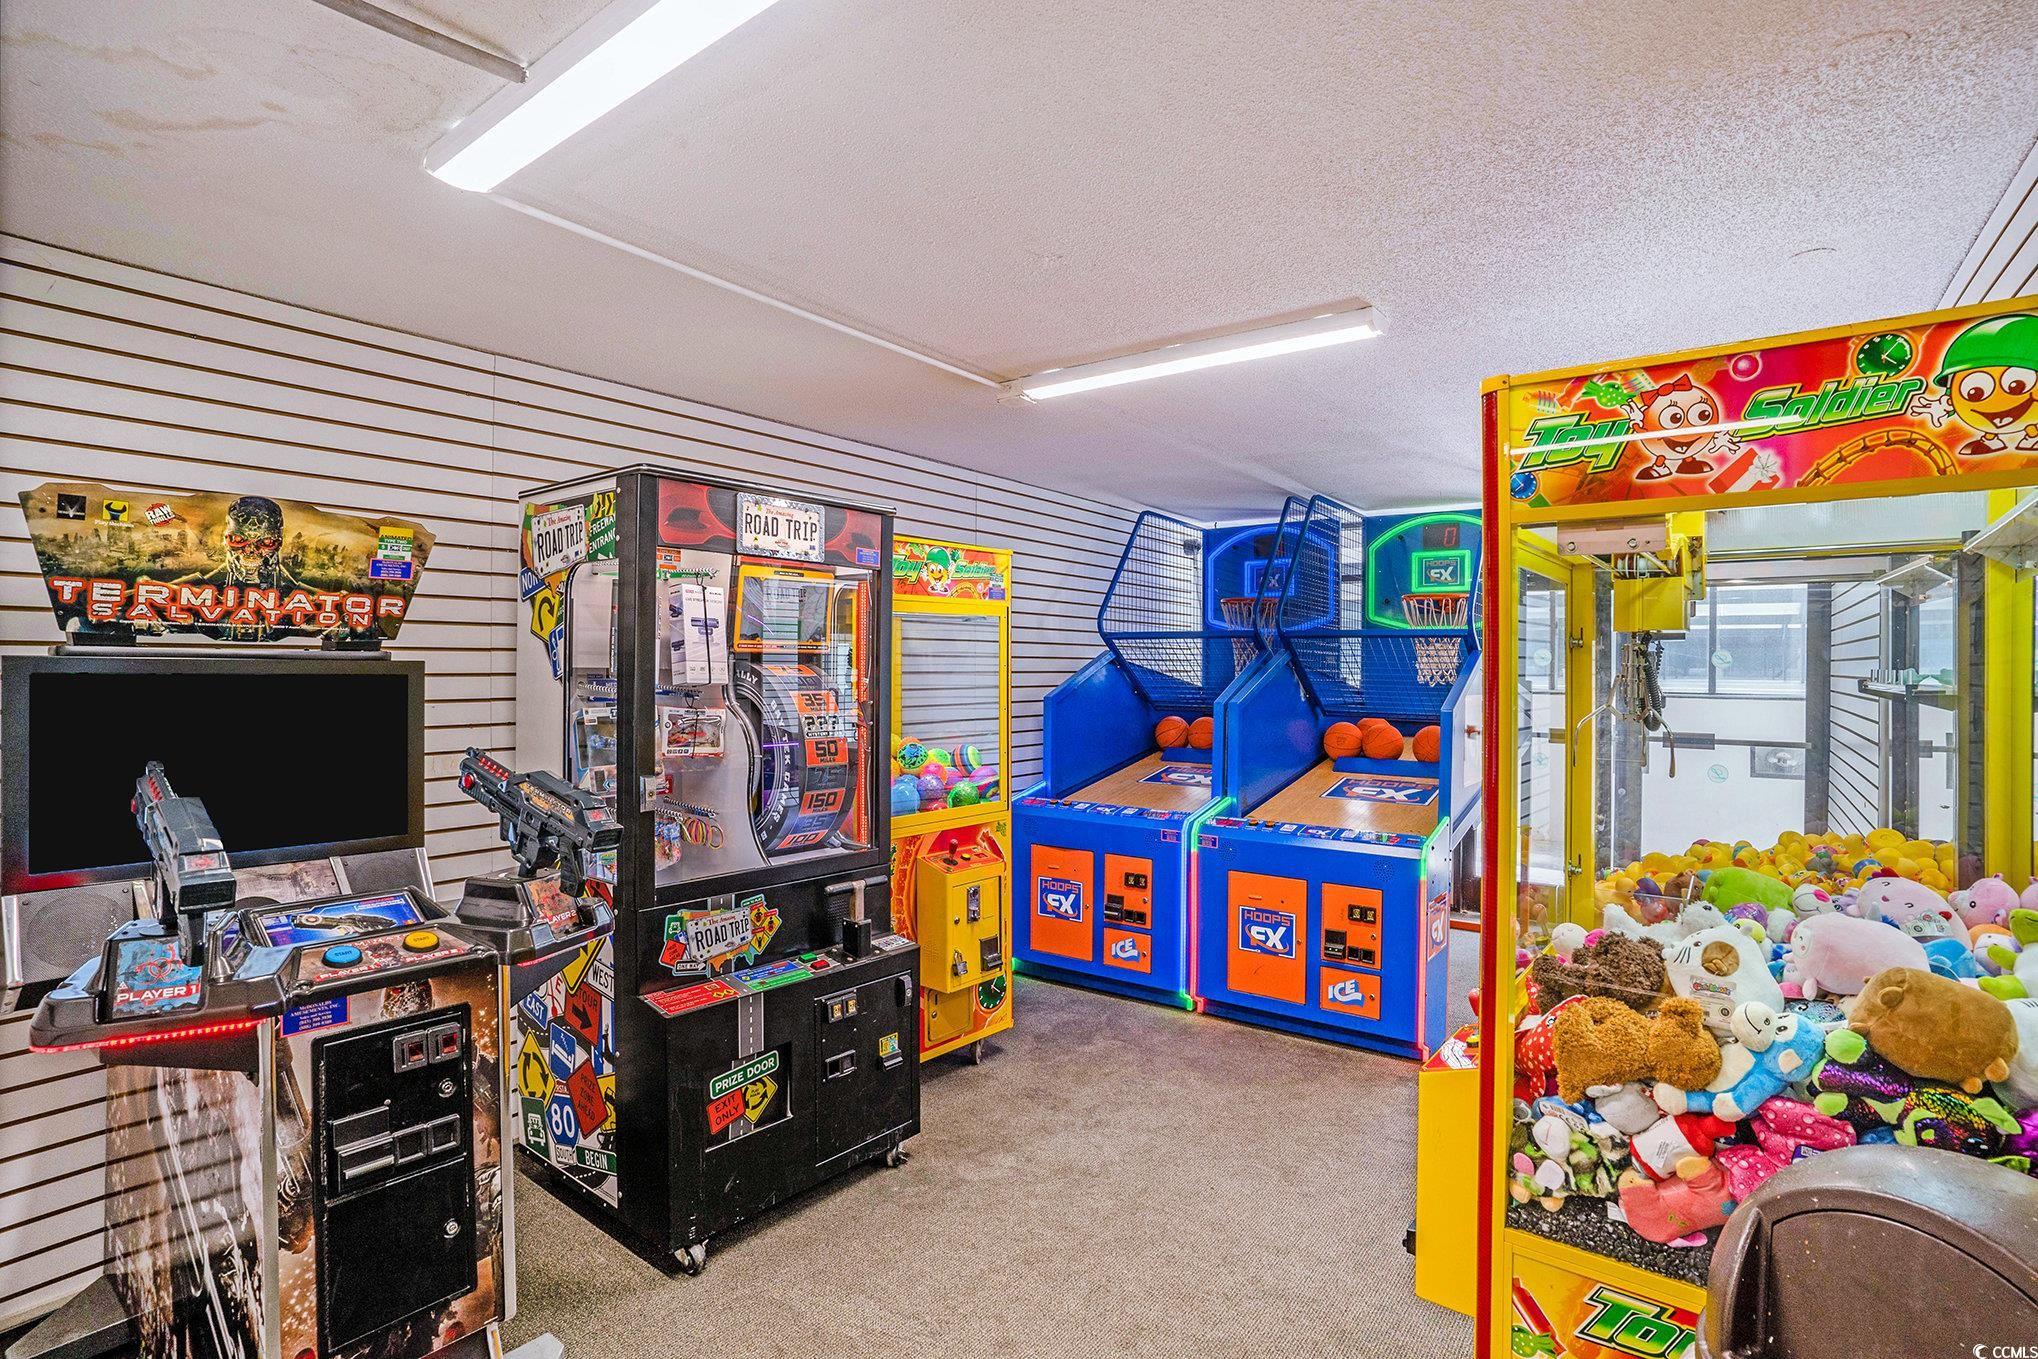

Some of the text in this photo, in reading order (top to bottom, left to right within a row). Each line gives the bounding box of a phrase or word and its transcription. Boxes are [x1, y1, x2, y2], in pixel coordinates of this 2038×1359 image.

[1520, 375, 1926, 474] Toy Soldier
[145, 505, 173, 519] RAW
[744, 513, 818, 541] ROAD TRIP
[1443, 527, 1457, 547] 0
[537, 521, 583, 563] ROAD TRIP
[53, 580, 406, 615] TERMINATOR
[92, 603, 370, 626] SALVATION
[801, 692, 827, 707] 35
[815, 740, 838, 757] 50
[807, 792, 837, 809] 150
[1042, 880, 1079, 894] HOOPS
[707, 917, 719, 926] The
[1244, 909, 1291, 927] HOOPS
[695, 925, 727, 952] ROAD
[729, 918, 750, 938] TRIP
[1111, 938, 1138, 958] ICE
[592, 964, 614, 992] WEST
[117, 985, 197, 1002] PLAYER 1
[1328, 979, 1363, 1001] ICE
[526, 997, 544, 1020] EAST
[715, 1058, 775, 1093] PRIZE DOOR
[715, 1094, 736, 1113] EXIT
[551, 1103, 575, 1138] 80
[715, 1105, 740, 1125] ONLY
[556, 1145, 574, 1162] SOUTH
[585, 1150, 608, 1170] BEGIN
